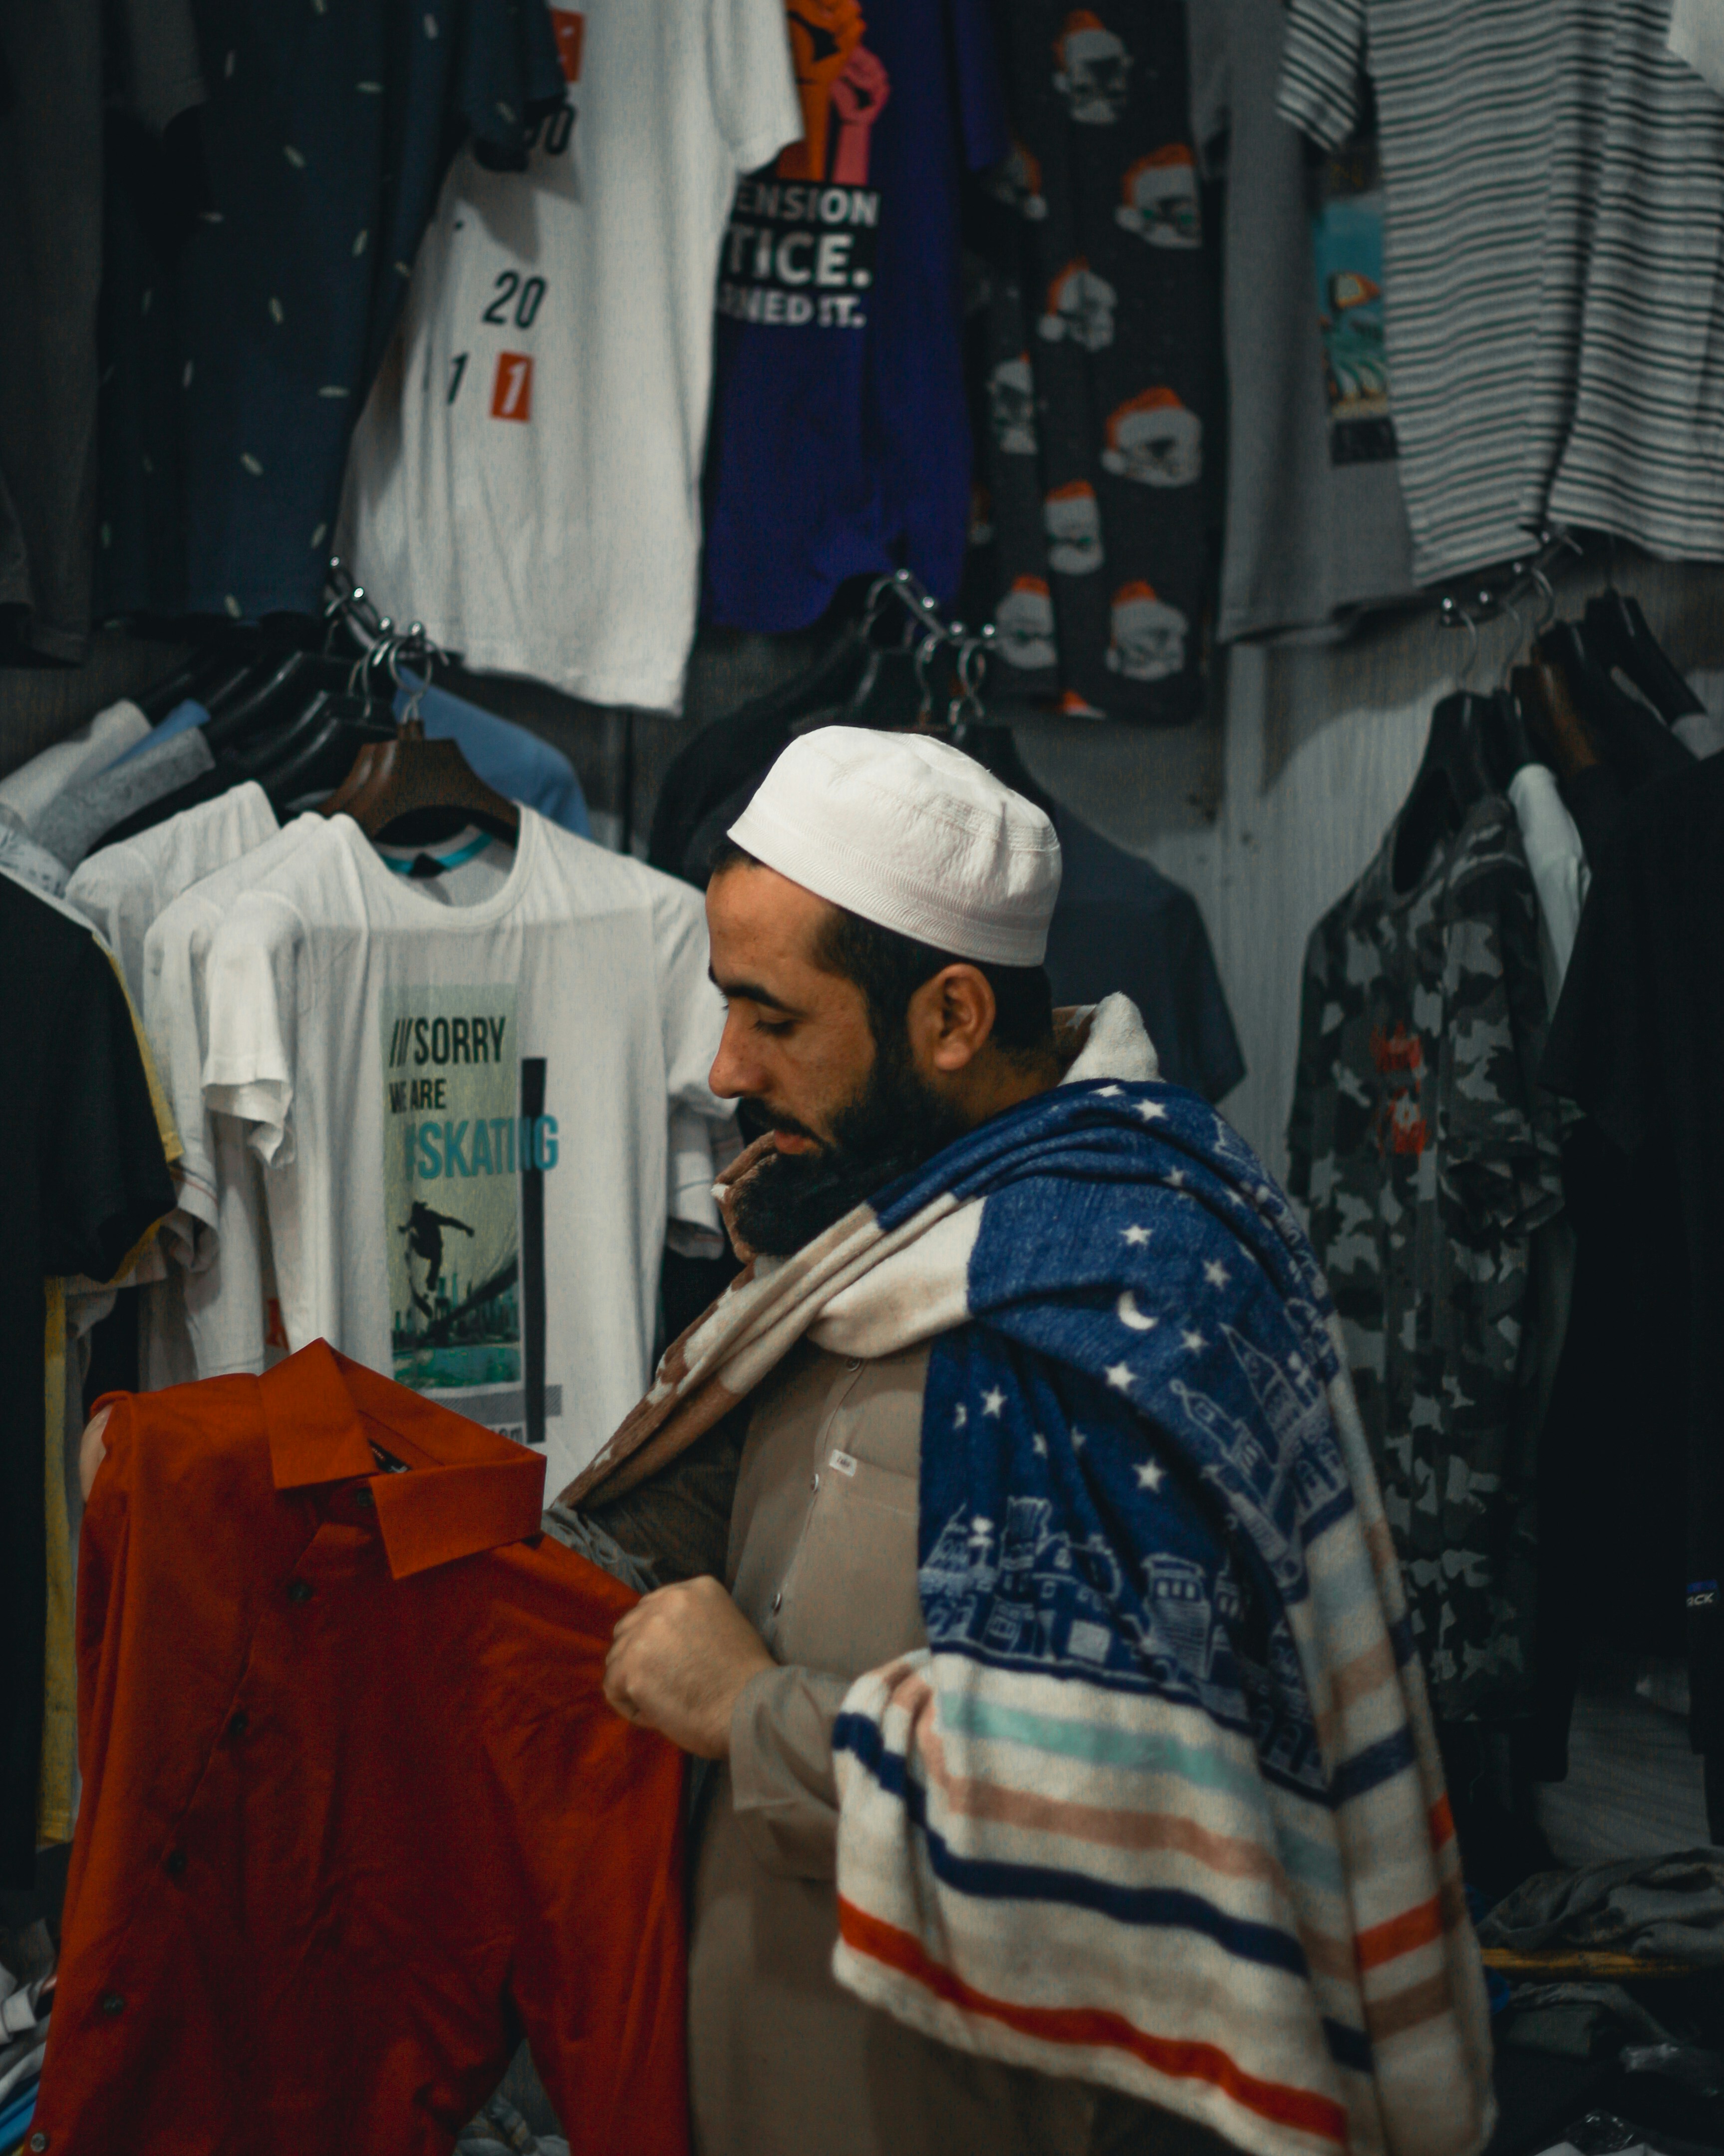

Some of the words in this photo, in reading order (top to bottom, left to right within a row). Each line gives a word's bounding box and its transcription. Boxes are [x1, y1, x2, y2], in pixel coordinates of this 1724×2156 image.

[730, 223, 871, 289] TICE.
[483, 271, 546, 329] 20
[448, 352, 468, 405] 1
[500, 361, 527, 415] 1
[411, 1078, 446, 1110] ARE
